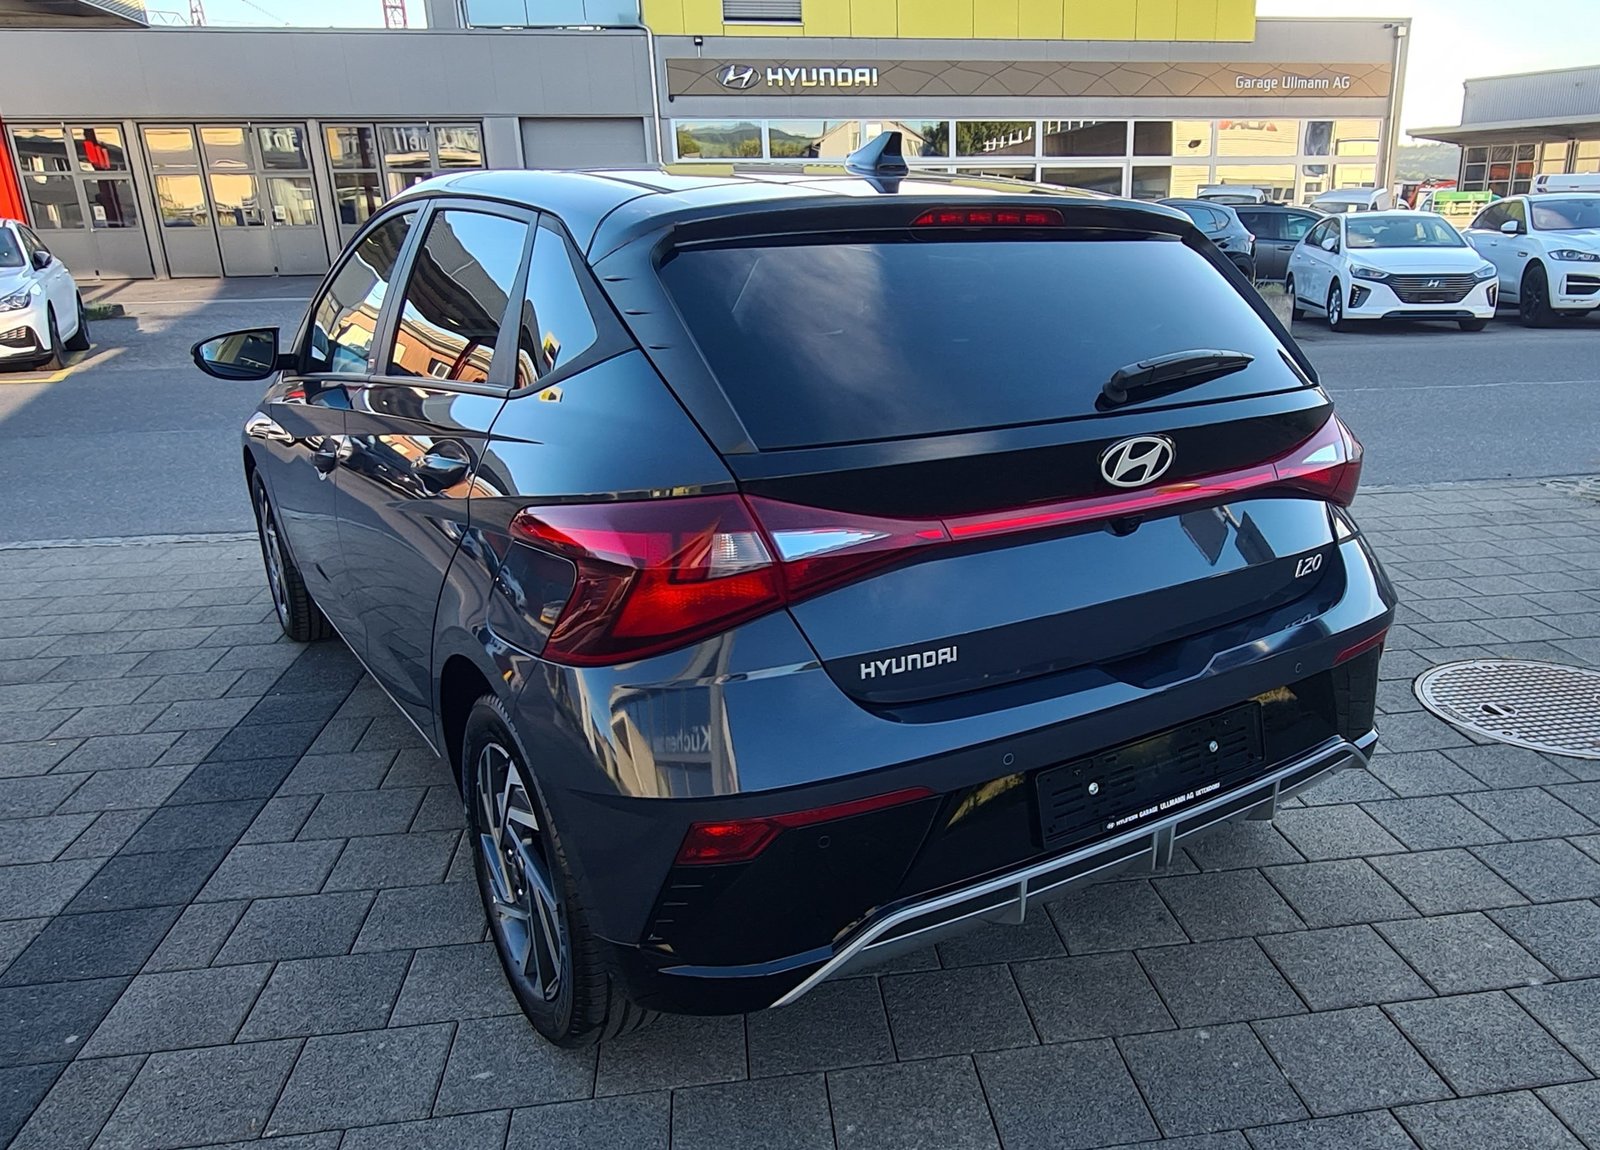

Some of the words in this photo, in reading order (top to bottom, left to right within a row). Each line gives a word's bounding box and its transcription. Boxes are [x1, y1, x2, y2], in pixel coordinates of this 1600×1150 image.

[767, 67, 879, 87] HYUNDAI
[1235, 75, 1278, 92] Garage
[1281, 75, 1329, 89] Ullmann
[1333, 76, 1351, 89] AG
[860, 646, 958, 680] HYUNDAI
[1139, 805, 1159, 818] GARAGE
[1159, 794, 1186, 810] ULLMANN
[1186, 791, 1195, 801] AG
